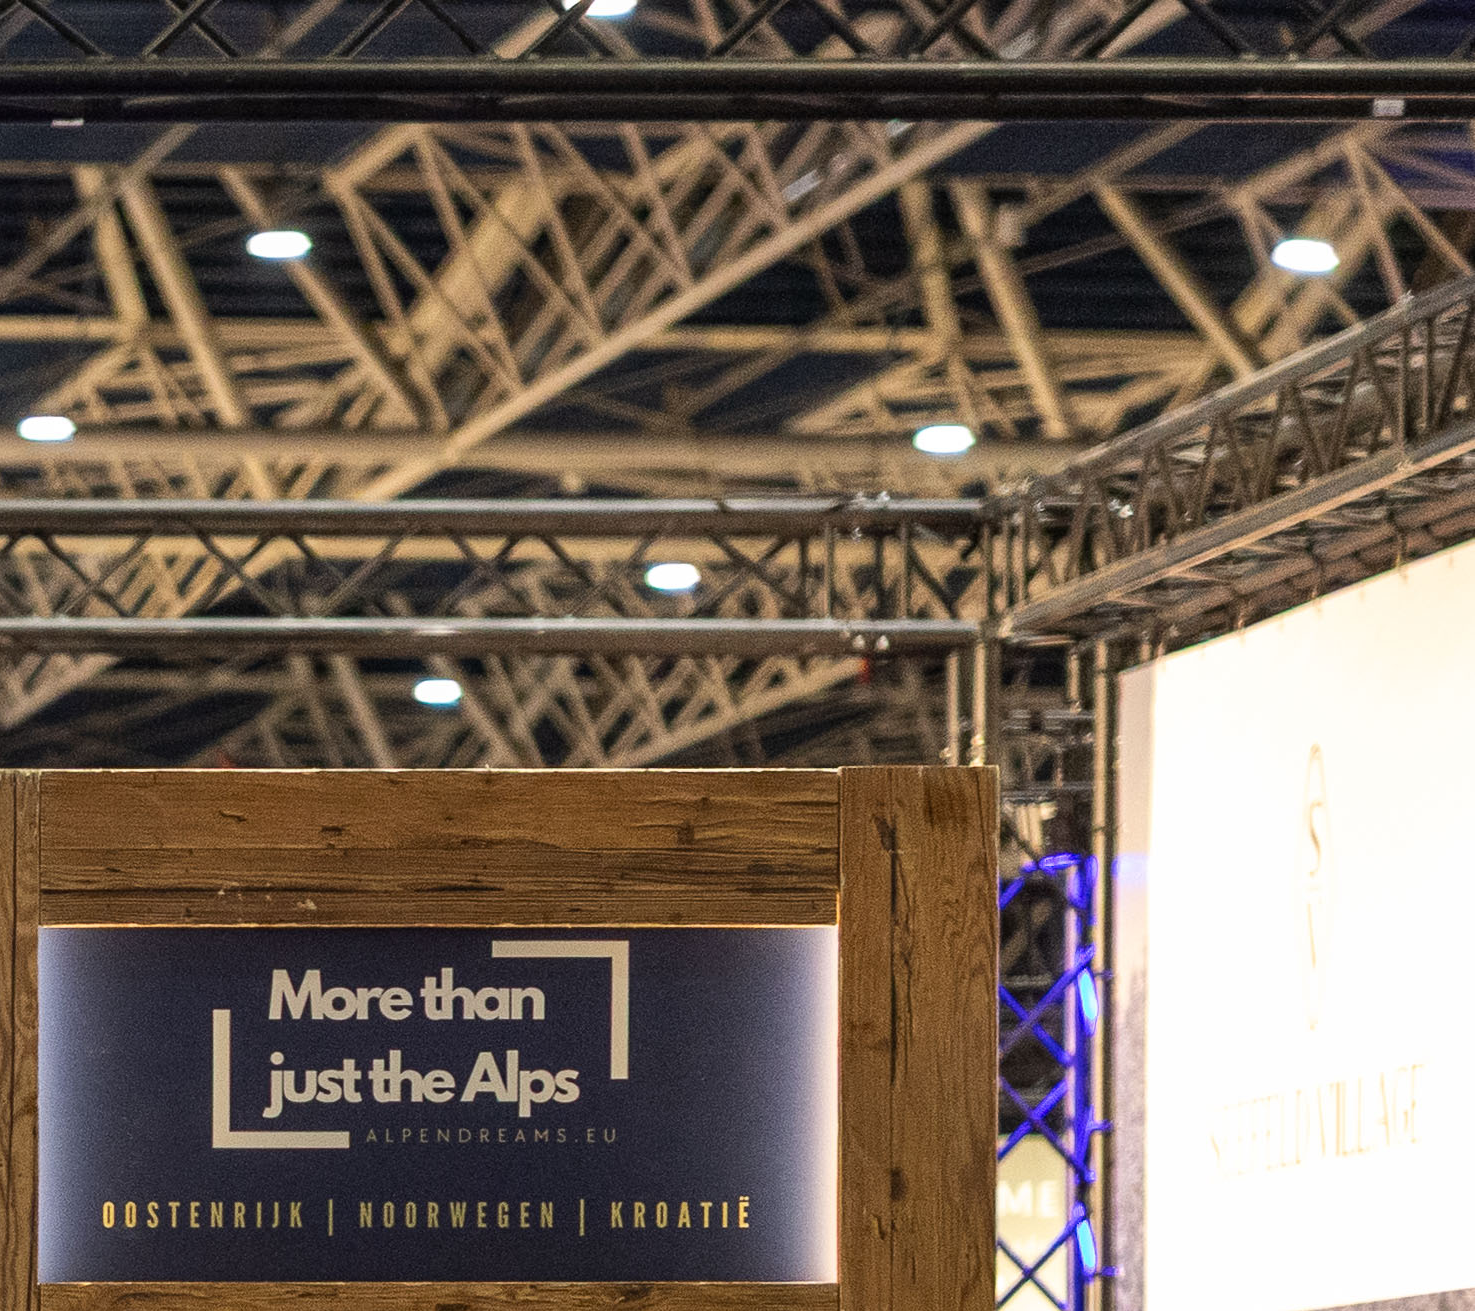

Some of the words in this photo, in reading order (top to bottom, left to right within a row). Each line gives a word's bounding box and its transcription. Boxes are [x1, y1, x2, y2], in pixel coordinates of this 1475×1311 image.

[268, 967, 413, 1022] More
[420, 965, 546, 1022] than
[262, 1051, 364, 1120] just
[367, 1048, 458, 1104] the
[460, 1048, 581, 1118] Alps
[365, 1126, 620, 1144] ALPENDREAMS.EU
[101, 1199, 305, 1230] OOSTENRIJK
[358, 1199, 556, 1230] NOORWEGEN
[610, 1193, 753, 1230] KROATIË
